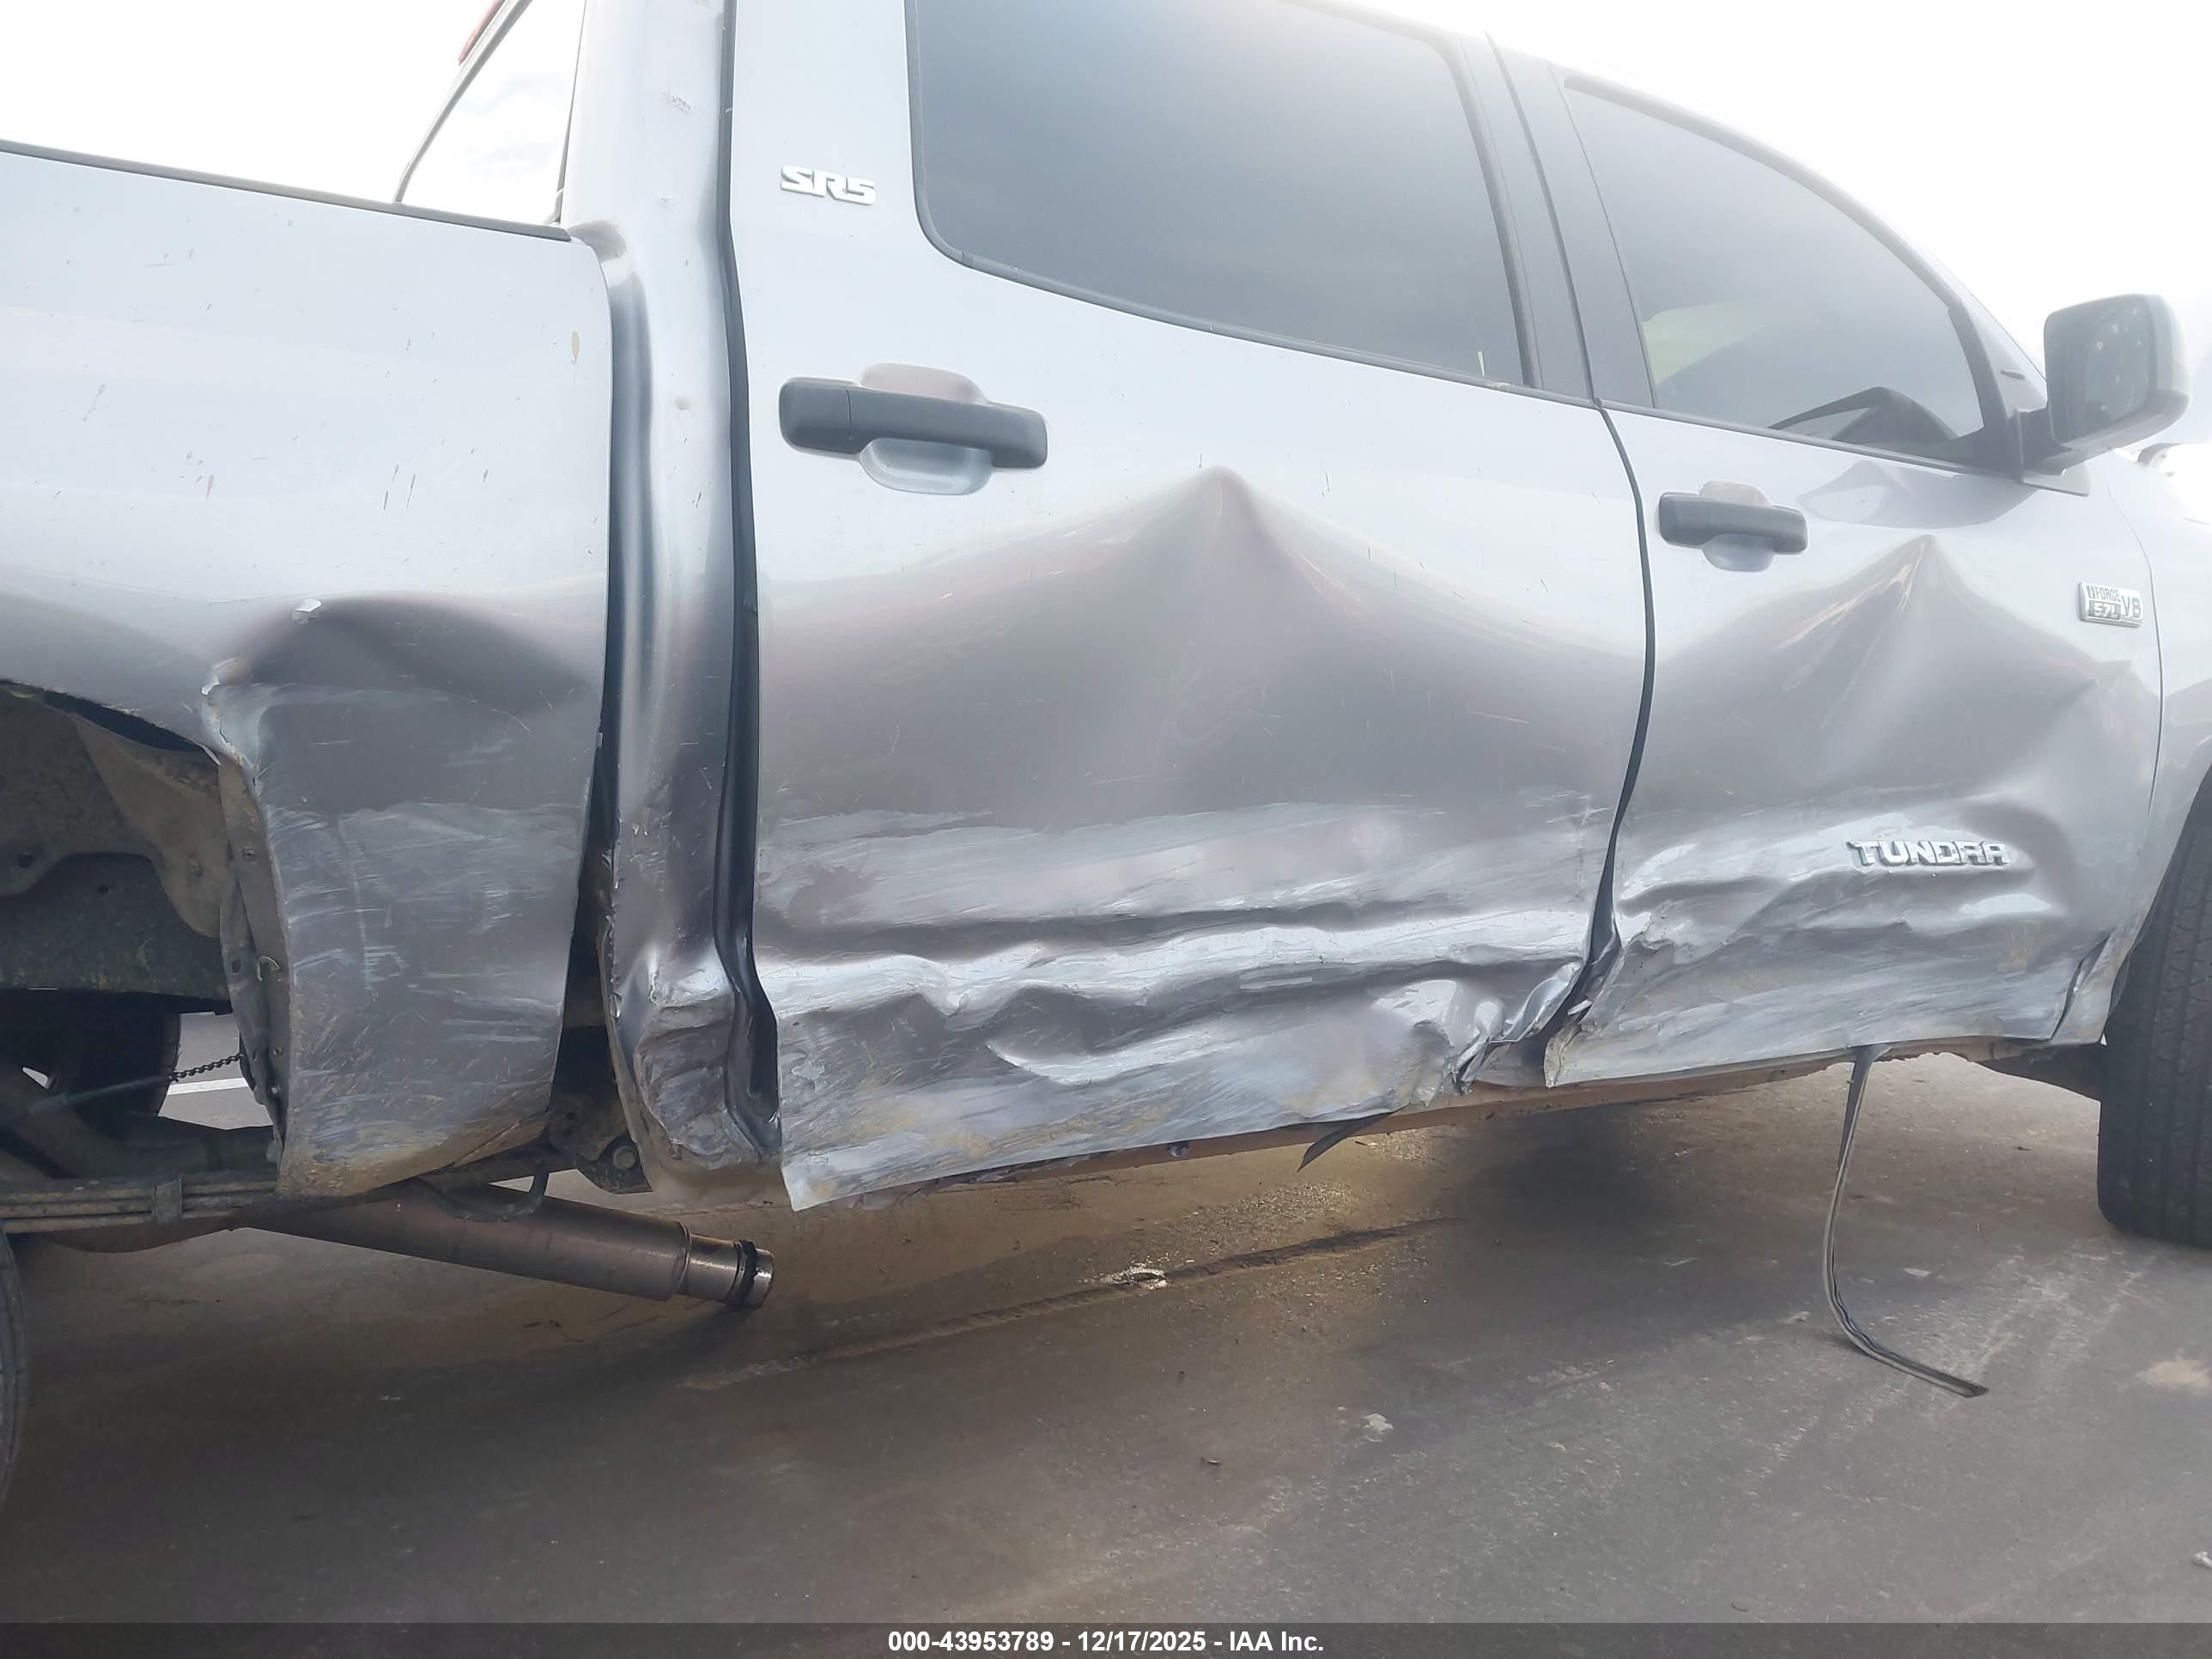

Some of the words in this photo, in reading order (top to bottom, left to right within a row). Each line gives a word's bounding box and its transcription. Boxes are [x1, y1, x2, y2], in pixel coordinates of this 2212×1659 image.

[781, 165, 876, 206] SR5
[2122, 595, 2142, 618] V8
[1846, 840, 2010, 866] TUNDRA
